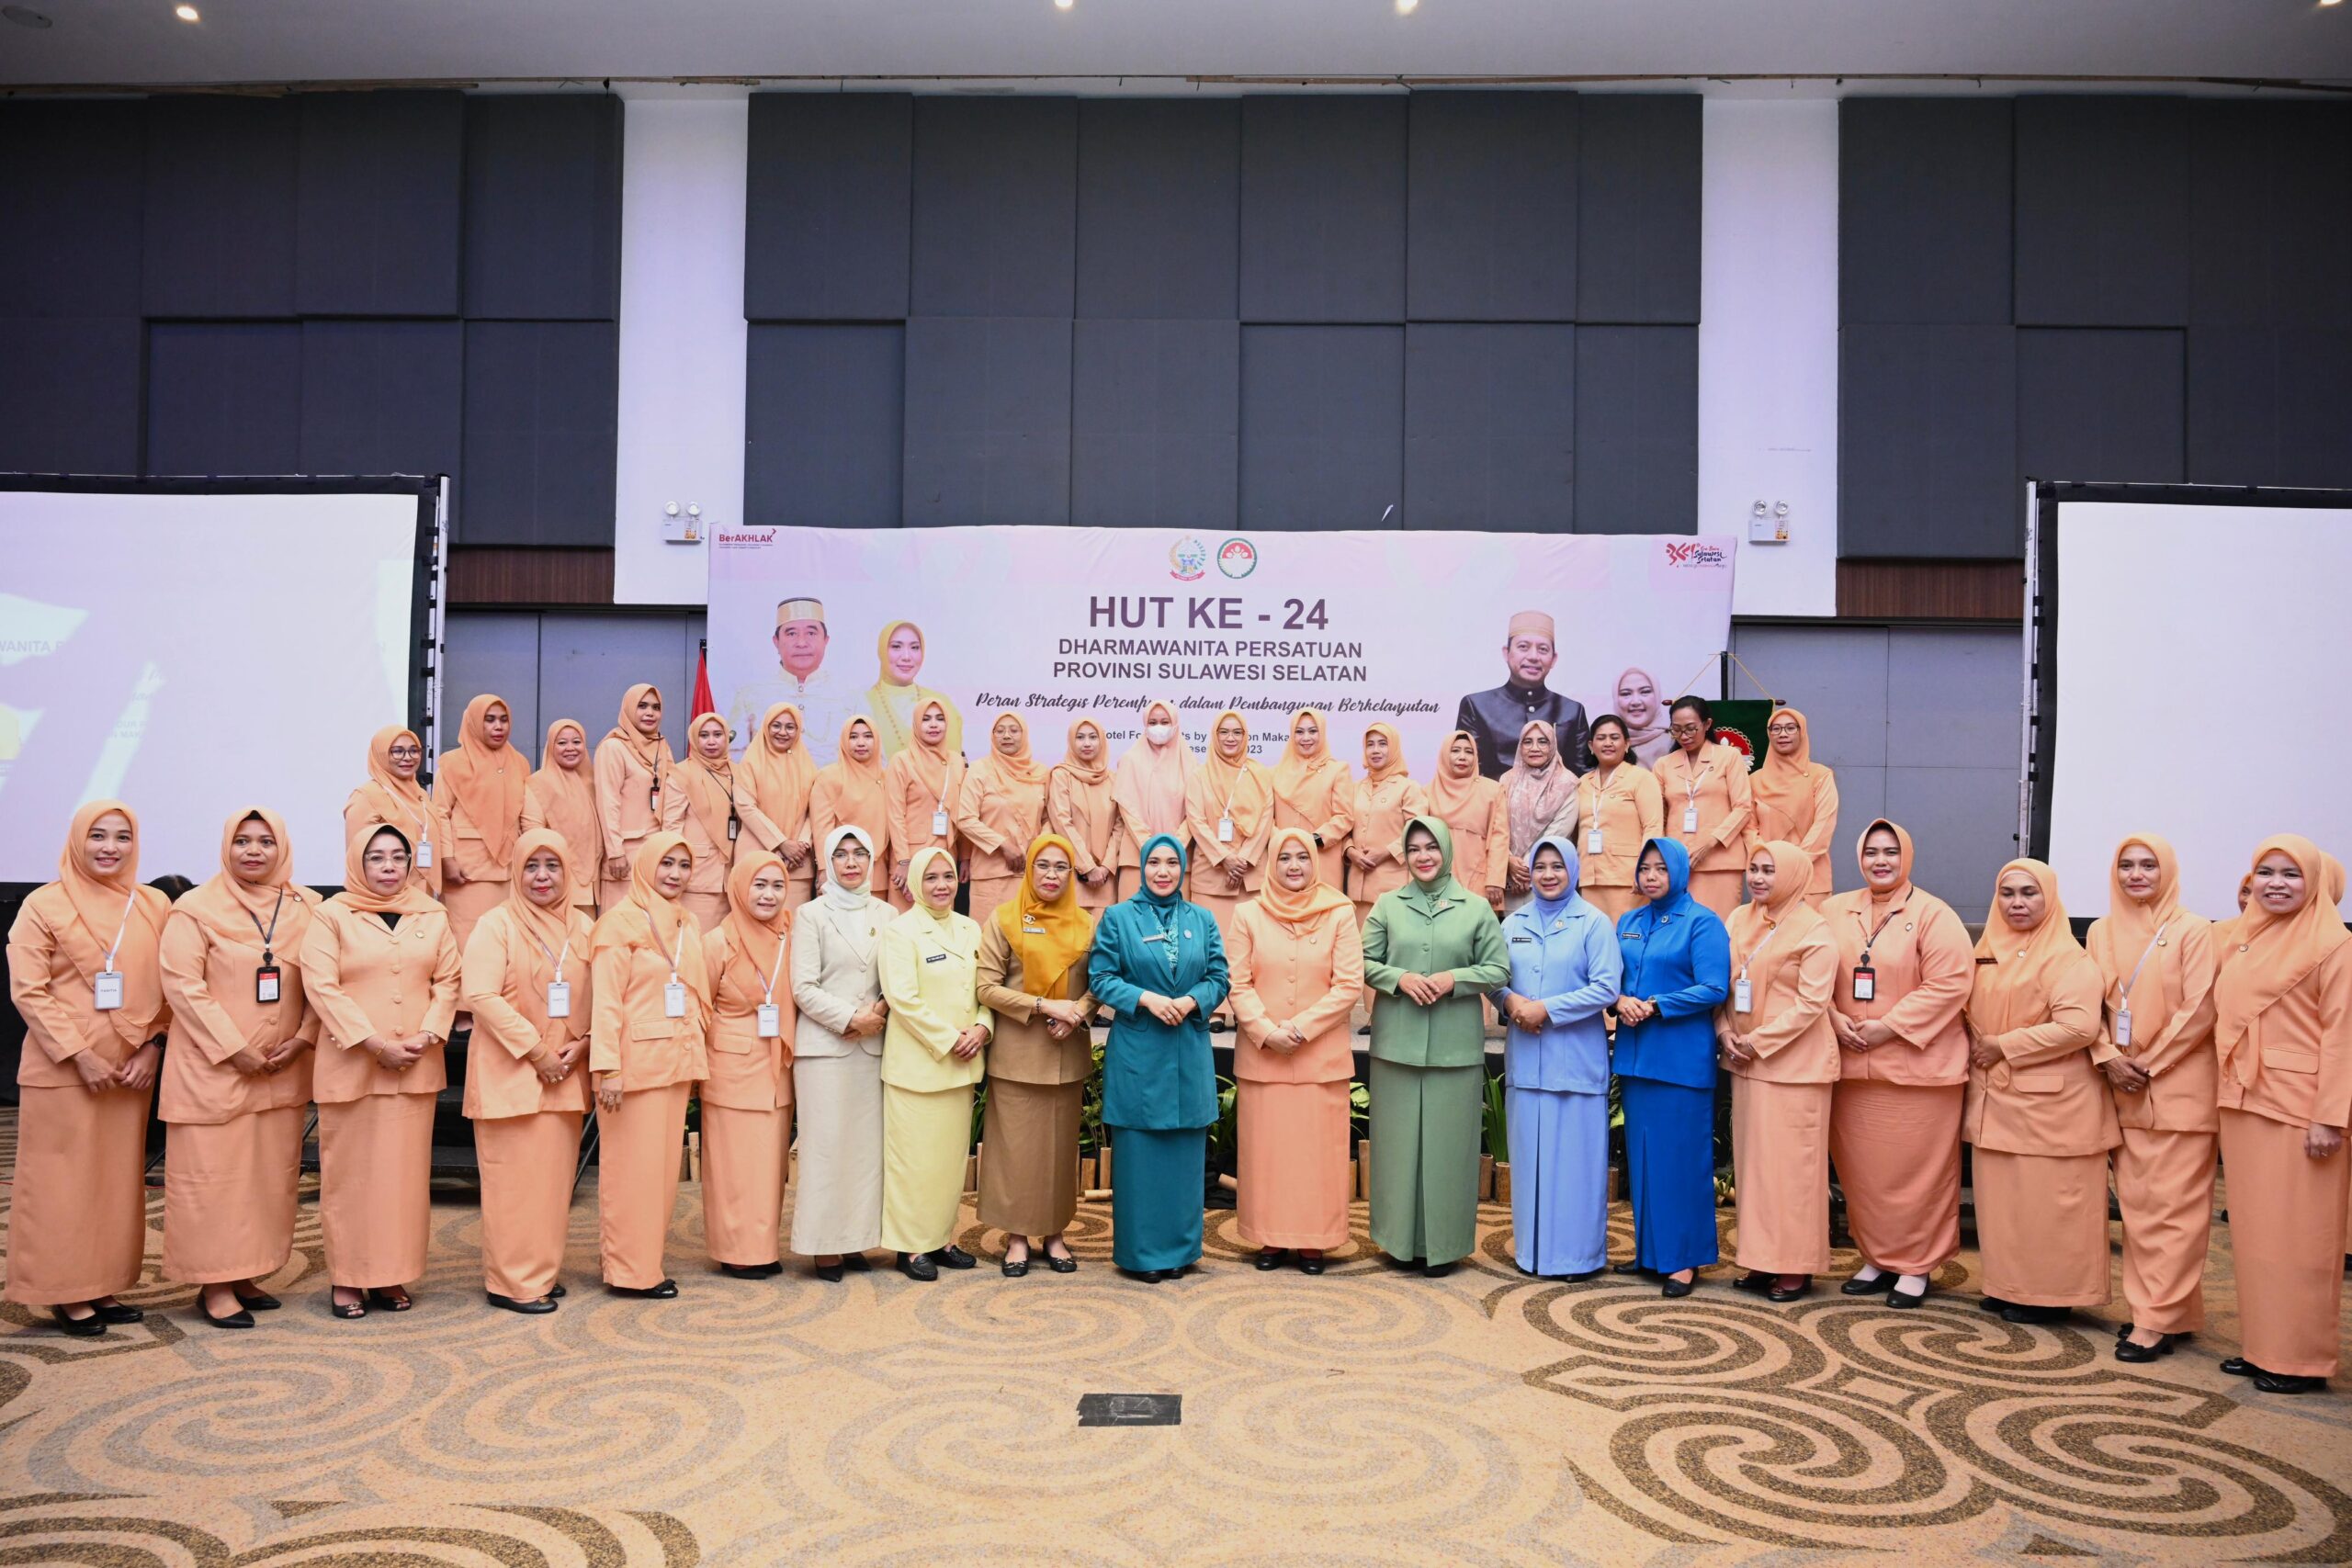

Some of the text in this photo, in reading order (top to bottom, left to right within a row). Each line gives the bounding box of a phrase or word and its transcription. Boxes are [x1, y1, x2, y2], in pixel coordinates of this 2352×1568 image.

[719, 534, 773, 542] BerAKHLAK
[1694, 550, 1726, 558] Sulawesi
[1697, 556, 1721, 564] Selatan
[1090, 596, 1173, 627] HUT
[1189, 597, 1242, 629] KE
[1283, 599, 1329, 630] 24
[1059, 638, 1362, 658] DHARMAWANITA PERSATUAN
[1054, 662, 1366, 682] PROVINSI SULAWESI SELATAN
[976, 693, 1021, 706] Peran
[1025, 694, 1089, 712] Strategis
[1092, 694, 1175, 713] Peremp
[1179, 695, 1225, 710] dalam
[1338, 697, 1440, 716] Berkelanjutan
[1106, 730, 1125, 739] otel
[1194, 731, 1207, 742] by
